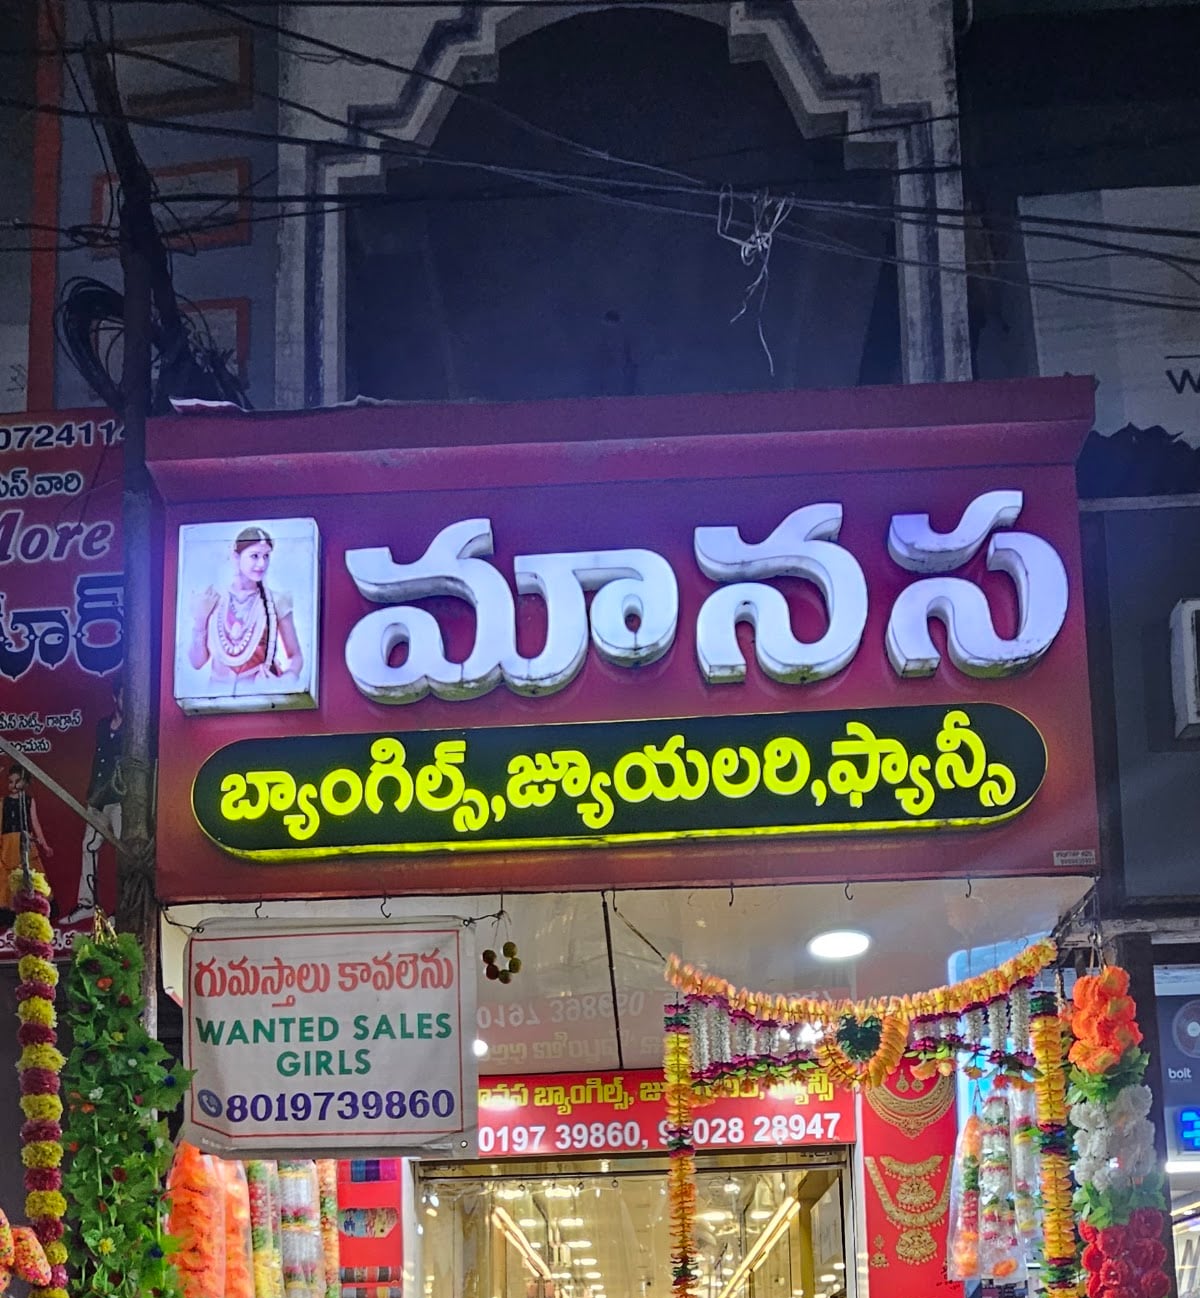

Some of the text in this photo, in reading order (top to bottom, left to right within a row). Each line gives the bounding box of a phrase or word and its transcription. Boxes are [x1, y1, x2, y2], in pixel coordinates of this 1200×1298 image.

[36, 472, 82, 496] వారి
[345, 489, 1069, 706] మానస
[194, 948, 455, 1008] గుమస్తాలు కావలెను
[195, 1013, 453, 1046] WANTED SALES
[276, 1048, 372, 1077] GIRLS
[1167, 1067, 1193, 1079] bolt
[225, 1088, 455, 1123] 8019739860
[478, 1112, 842, 1153] 0197 39860, 9028 28947
